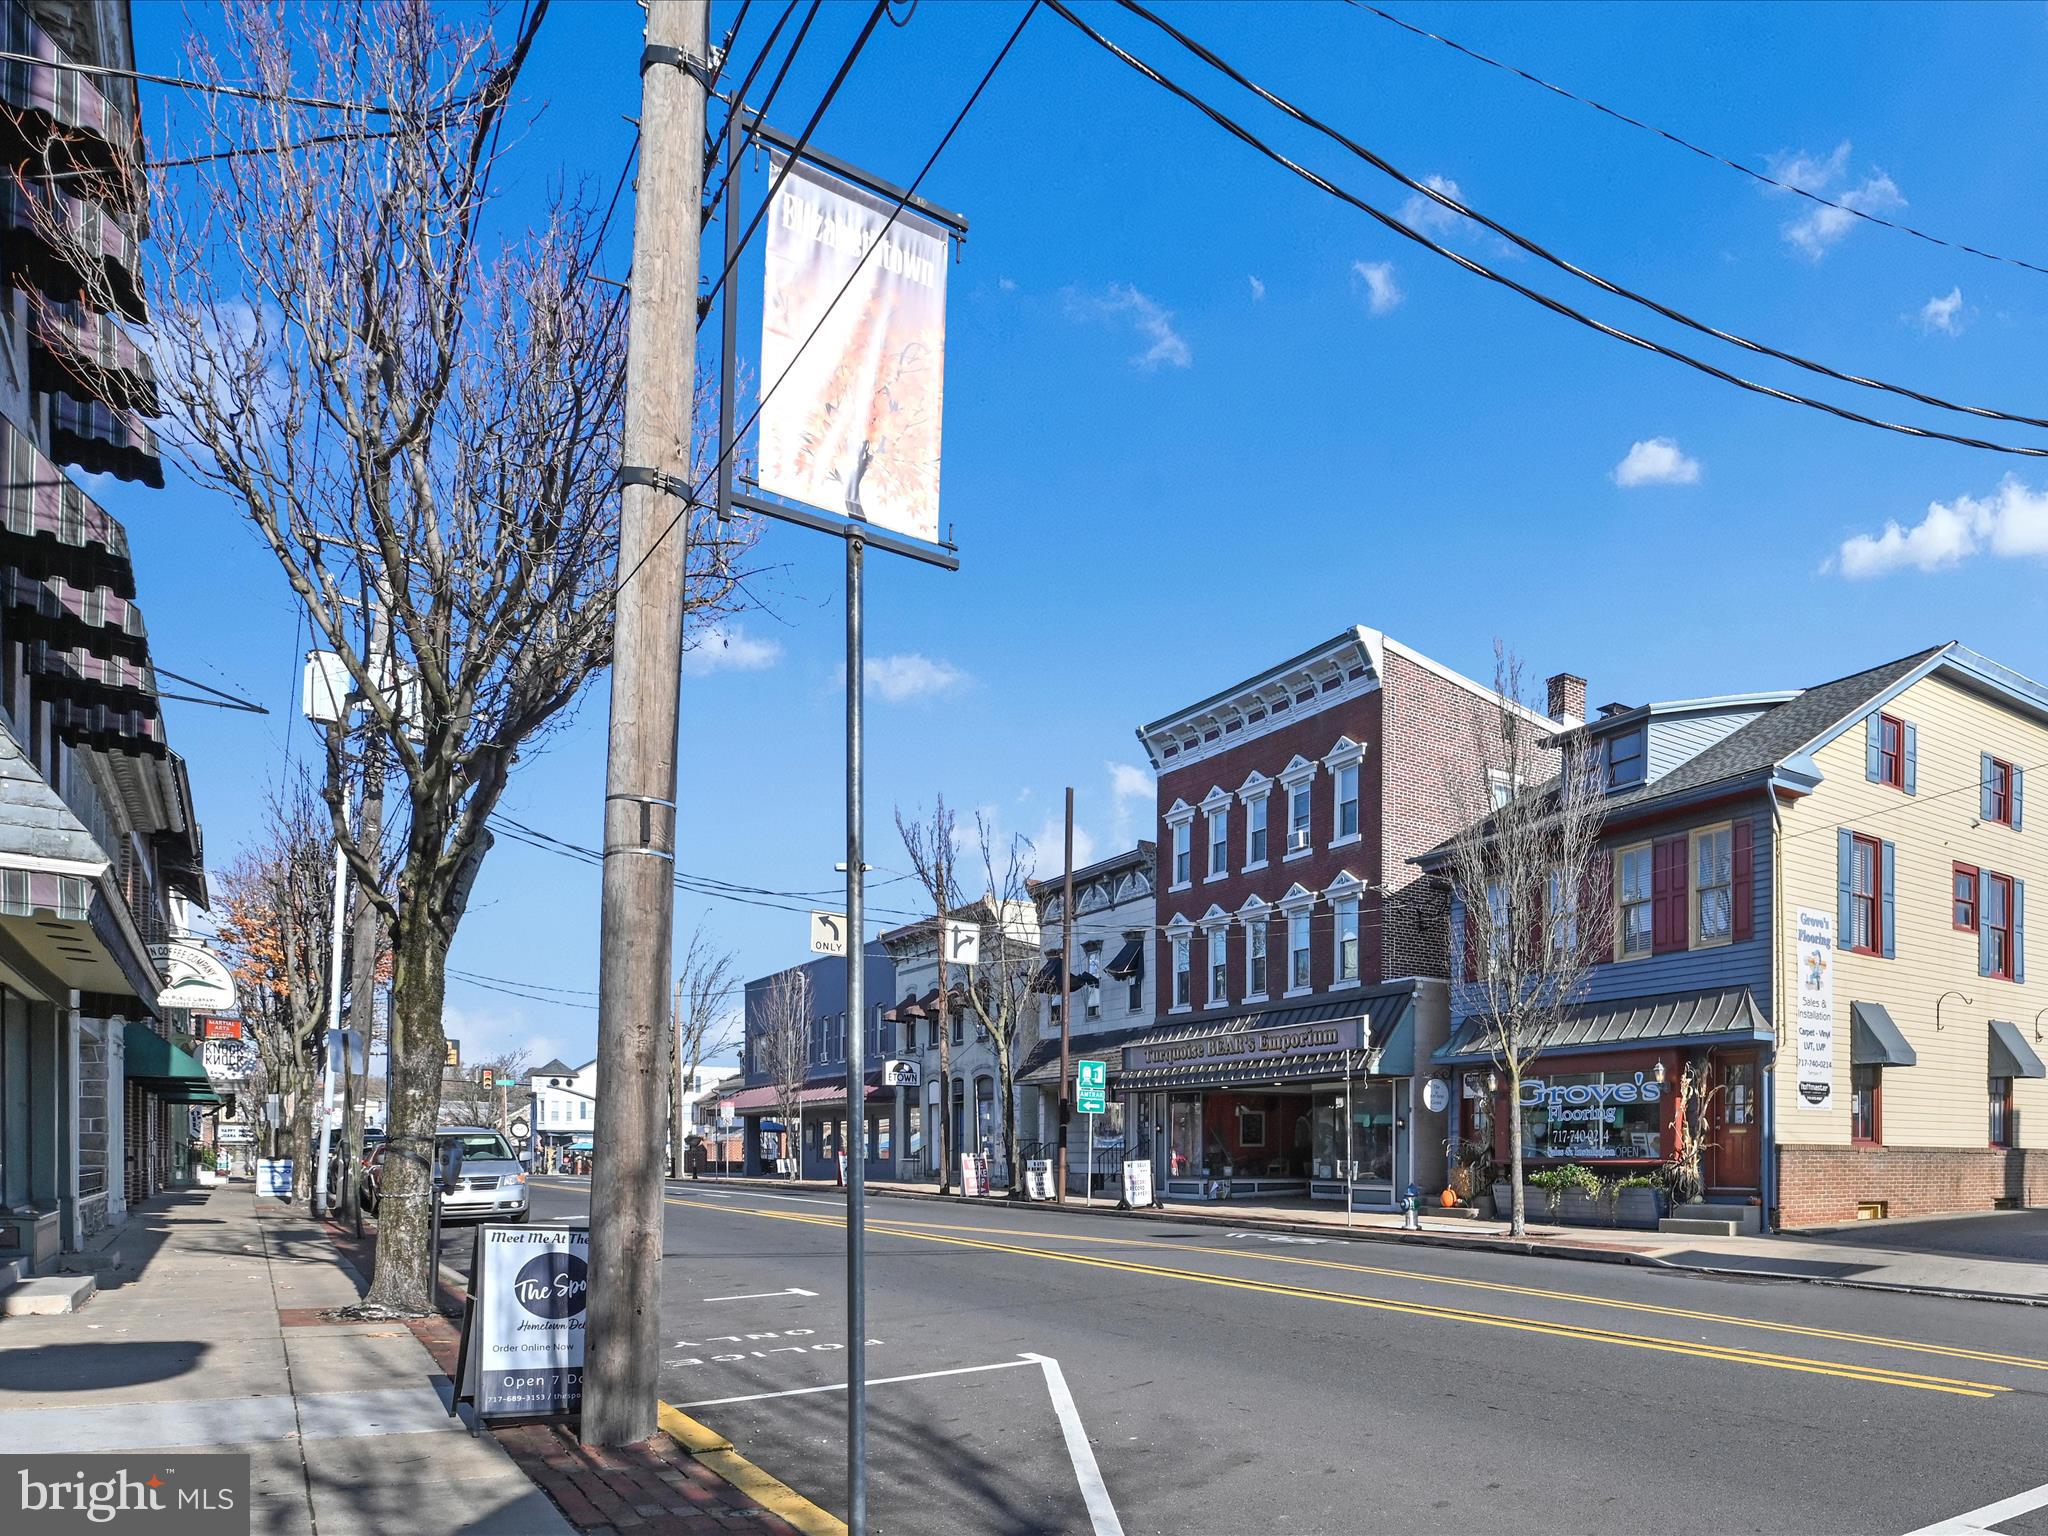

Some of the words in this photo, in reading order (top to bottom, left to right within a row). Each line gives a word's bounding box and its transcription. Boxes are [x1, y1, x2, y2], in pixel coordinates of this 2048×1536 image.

[1800, 912, 1829, 930] Grove's
[1797, 928, 1832, 950] Flooring
[815, 941, 843, 952] ONLY
[157, 946, 187, 959] COFFEE
[187, 953, 218, 976] COMPANY
[1802, 996, 1820, 1008] Sales
[1821, 999, 1827, 1008] &
[1798, 1009, 1831, 1021] Installation
[1799, 1027, 1815, 1036] Carpet
[1819, 1029, 1831, 1039] Vinyl
[205, 1043, 244, 1055] KNOCK
[1144, 1044, 1204, 1065] Turquoise
[1207, 1033, 1255, 1057] BEAR's
[1259, 1026, 1339, 1055] Emporium
[1803, 1042, 1815, 1051] LVT,
[1798, 1058, 1832, 1068] 717-740-0214
[888, 1073, 917, 1082] ETOWN
[1519, 1071, 1661, 1106] Grove's
[1080, 1091, 1104, 1099] AMTRAK
[1547, 1105, 1617, 1123] Flooring
[1552, 1129, 1610, 1145] 717-740-024
[1616, 1146, 1639, 1157] OPEN
[491, 1231, 525, 1243] Meet
[527, 1232, 550, 1244] Me
[551, 1233, 566, 1244] At
[569, 1233, 590, 1244] The
[514, 1279, 552, 1303] The
[517, 1320, 567, 1332] Hometown
[492, 1344, 518, 1353] Order
[521, 1343, 551, 1352] Online
[553, 1343, 574, 1351] Now
[503, 1375, 545, 1389] Open
[552, 1375, 559, 1385] 7
[487, 1394, 545, 1404] 717-689-3153
